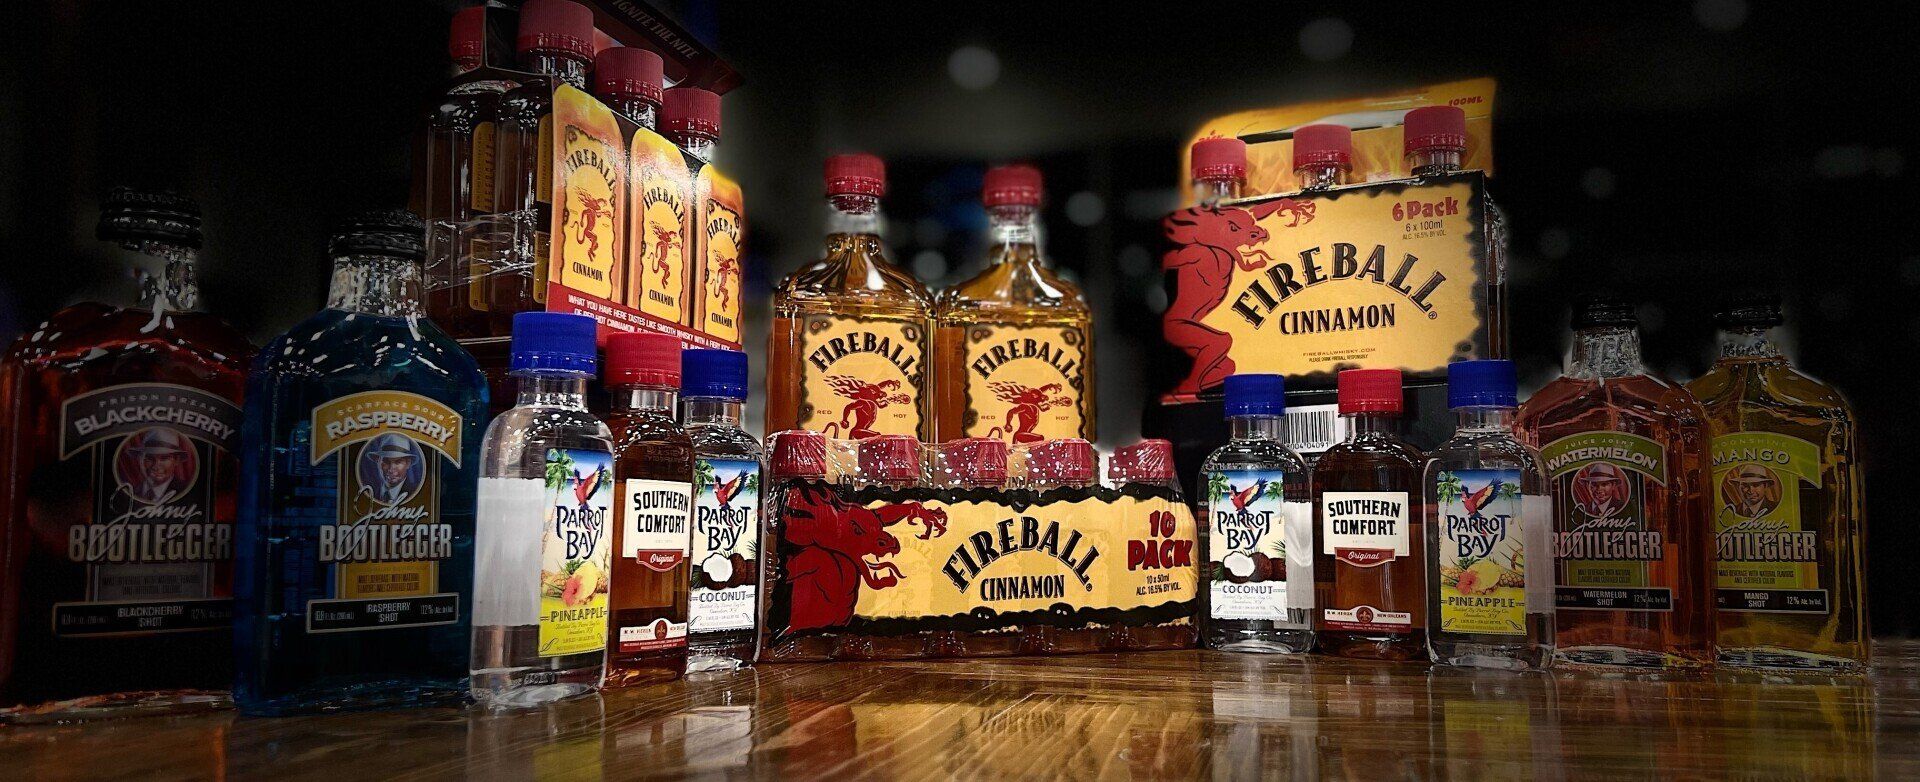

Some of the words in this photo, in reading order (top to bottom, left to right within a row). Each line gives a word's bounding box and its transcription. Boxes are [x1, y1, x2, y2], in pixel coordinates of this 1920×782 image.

[650, 21, 677, 42] THE
[670, 38, 701, 60] NITE
[566, 149, 616, 191] FIREBALL
[643, 187, 685, 224] FIREBALL
[1392, 202, 1404, 222] 6
[1406, 196, 1459, 220] Pack
[1405, 223, 1411, 232] 6
[1420, 219, 1443, 231] 100ml
[573, 260, 604, 282] CINNAMON
[650, 289, 675, 308] CINNAMON
[1231, 242, 1448, 331] FIREBALL
[568, 294, 586, 307] WHAT
[587, 300, 598, 311] YOU
[598, 304, 613, 316] HAVE
[613, 309, 628, 321] HERE
[628, 313, 646, 327] TASTES
[646, 319, 657, 330] LIKE
[657, 323, 677, 336] SMOOTH
[677, 329, 694, 341] WHISKY
[694, 335, 706, 346] WITH
[1280, 303, 1397, 336] CINNAMON
[809, 331, 920, 380] FIREBALL
[971, 338, 1082, 382] FIREBALL
[74, 406, 237, 438] BLACKCHERRY
[326, 411, 456, 443] RASPBERRY
[1546, 446, 1658, 471] WATERMELON
[1712, 447, 1790, 467] MANGO
[634, 490, 689, 512] SOUTHERN
[1328, 500, 1402, 518] SOUTHERN
[556, 505, 608, 540] PARROT
[638, 513, 686, 533] COMFORT
[698, 505, 752, 534] PARROT
[1149, 509, 1176, 538] 10
[1217, 511, 1275, 536] PARROT
[1446, 515, 1512, 542] PARROT
[69, 522, 232, 562] BOOTLEGGER
[319, 523, 452, 561] BOOTLEGGER
[566, 529, 600, 560] BAY
[708, 526, 742, 551] BAY
[1227, 528, 1264, 550] BAY
[1457, 534, 1499, 558] BAY
[650, 553, 675, 566] Original
[941, 516, 1100, 594] FIREBALL
[1127, 539, 1194, 571] PACK
[1348, 551, 1380, 561] Original
[700, 590, 748, 603] COCONUT
[980, 575, 1065, 602] CINNAMON
[1222, 585, 1273, 595] COCONUT
[1583, 591, 1628, 599] WATERMELON
[1744, 592, 1769, 600] MANGO
[366, 601, 411, 615] RASPBERRY
[551, 606, 604, 622] PINEAPPLE
[1448, 596, 1516, 608] PINEAPPLE
[1597, 598, 1614, 606] SHOT
[1748, 600, 1765, 608] SHOT
[378, 612, 400, 624] SHOT
